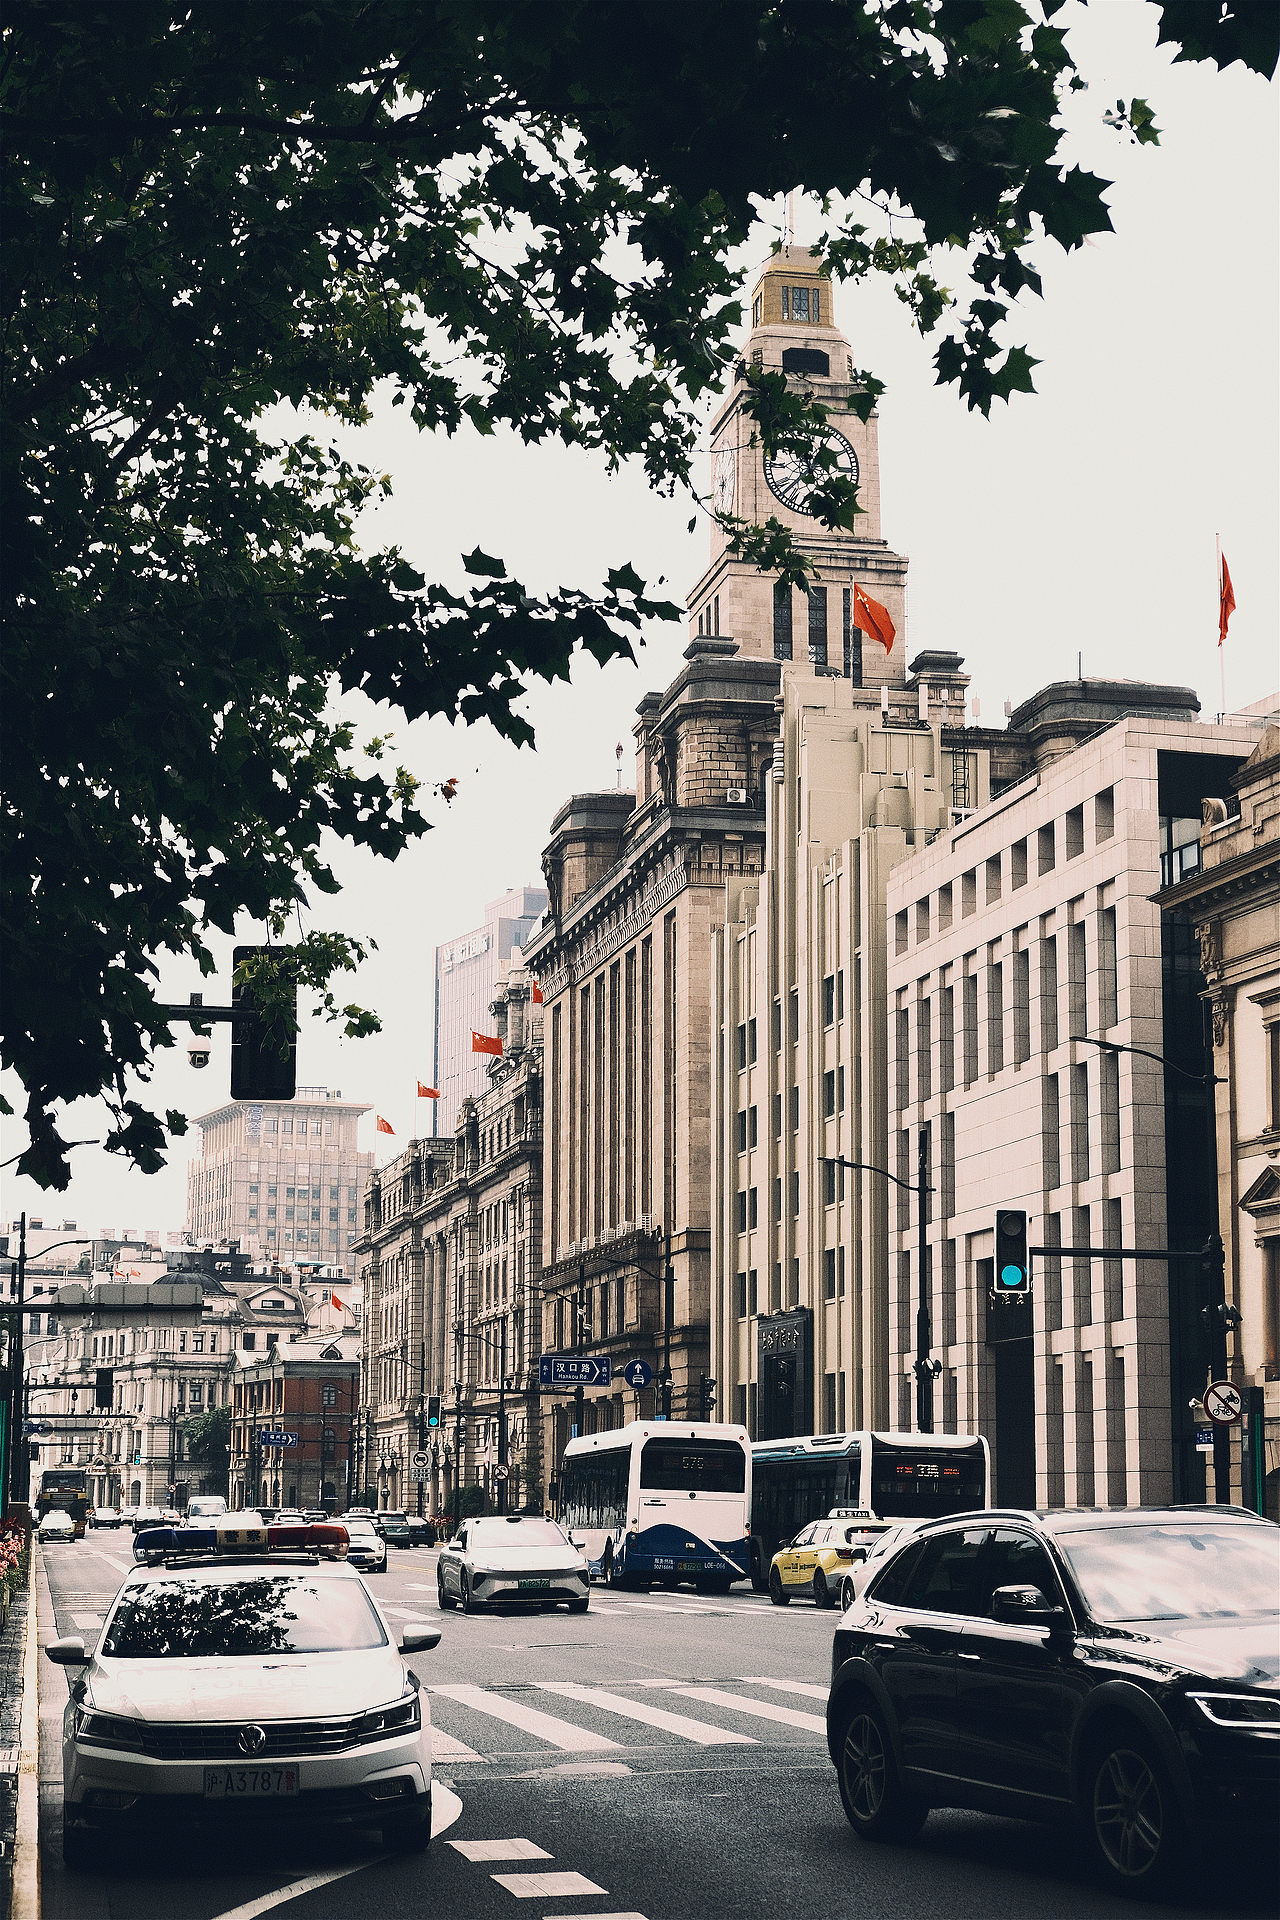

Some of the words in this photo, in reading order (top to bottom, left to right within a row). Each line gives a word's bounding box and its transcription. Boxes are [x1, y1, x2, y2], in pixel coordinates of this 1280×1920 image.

[556, 1363, 590, 1373] 汉口路
[224, 1529, 261, 1543] 警察
[190, 1679, 309, 1689] POLICE
